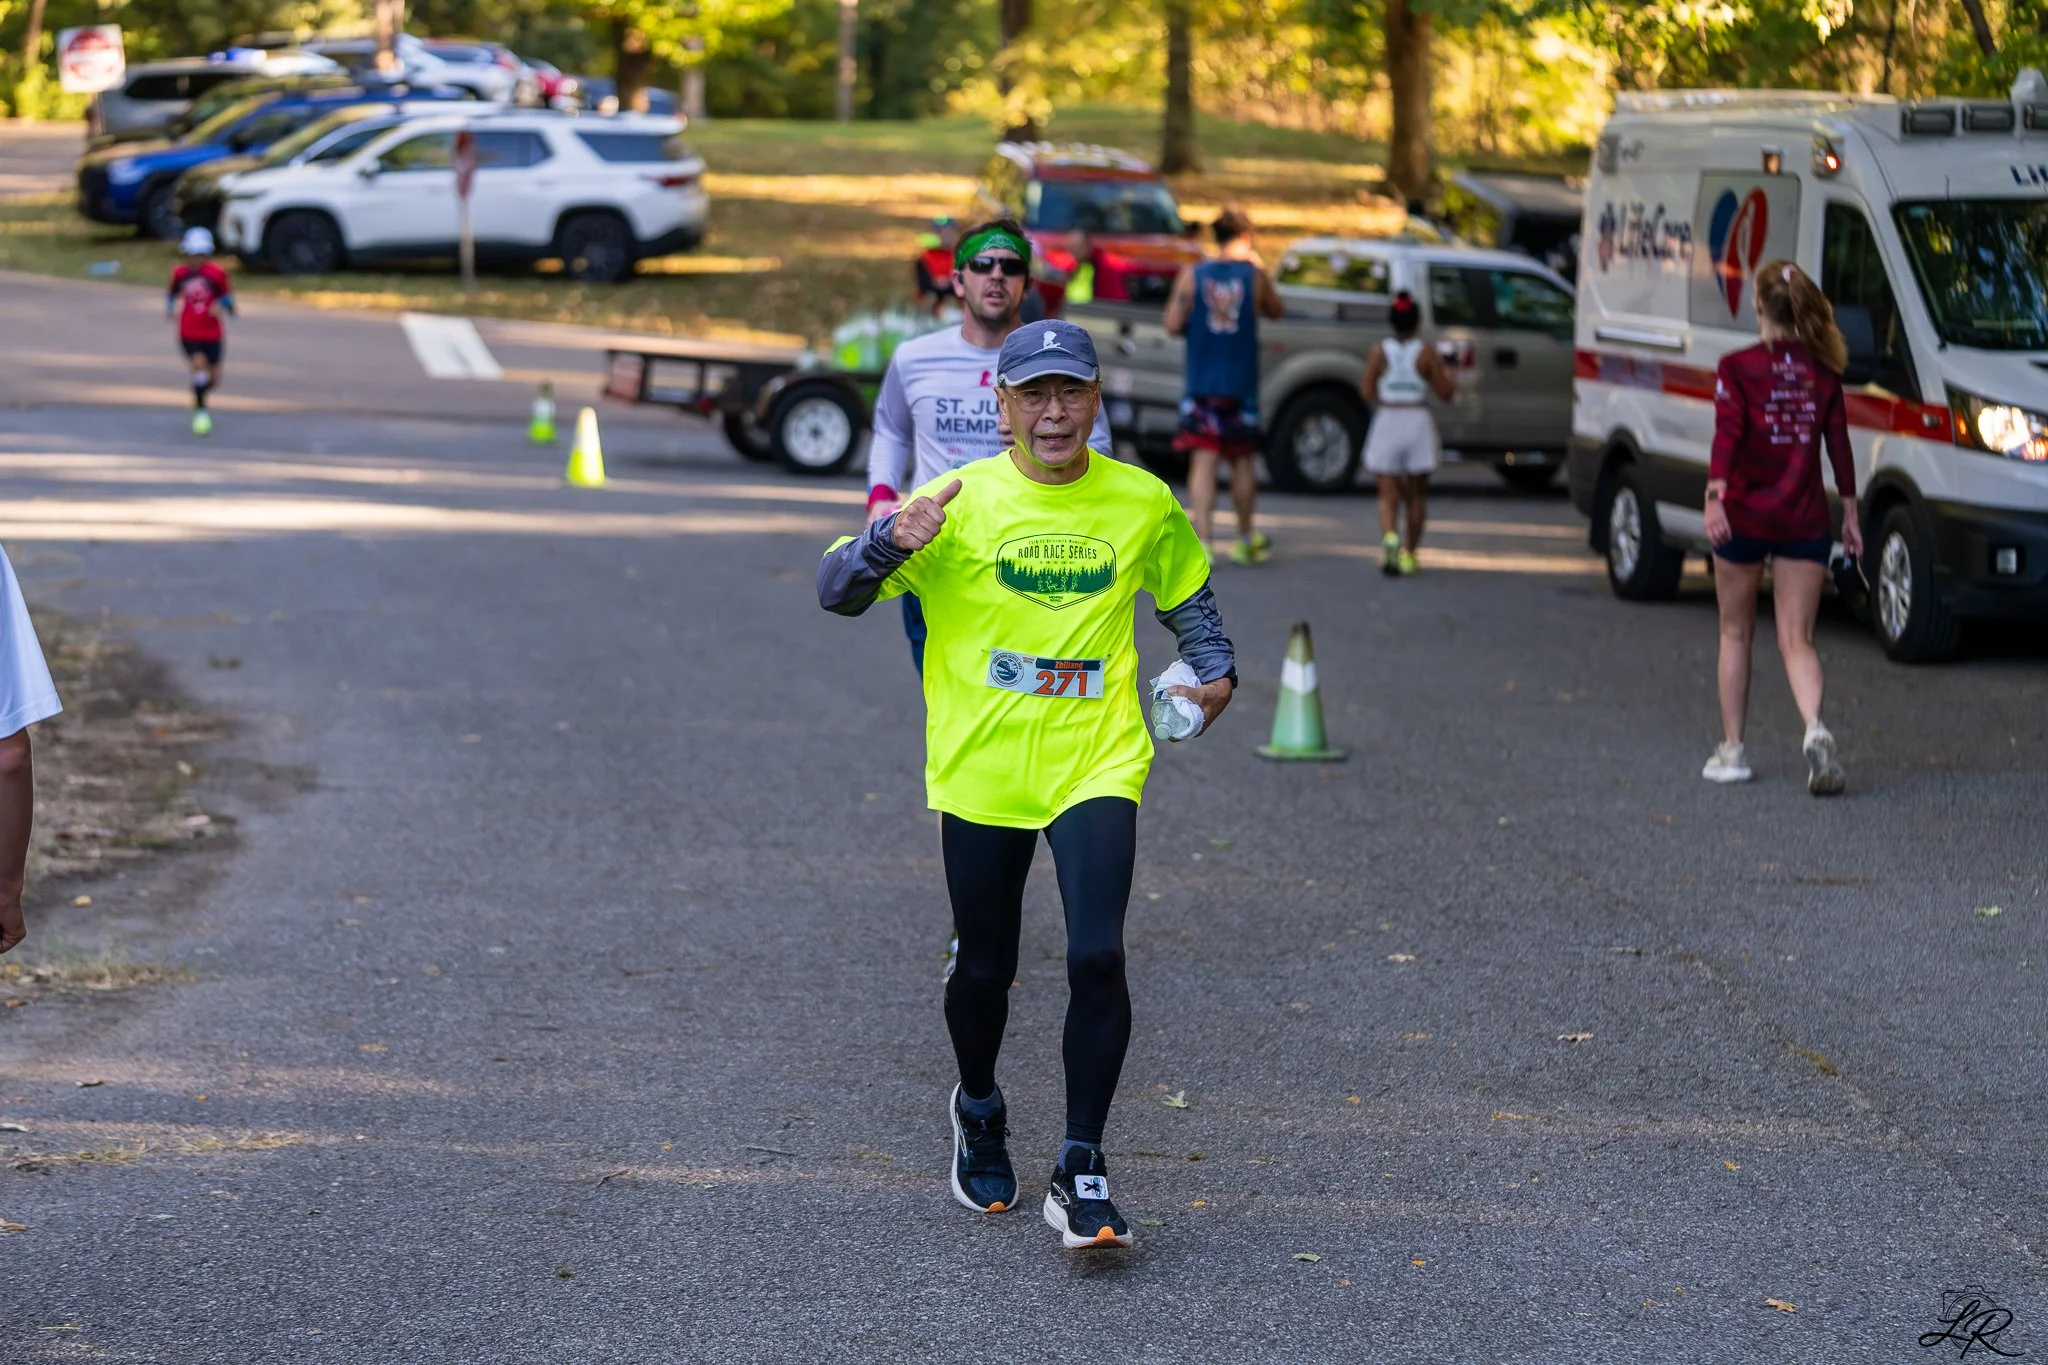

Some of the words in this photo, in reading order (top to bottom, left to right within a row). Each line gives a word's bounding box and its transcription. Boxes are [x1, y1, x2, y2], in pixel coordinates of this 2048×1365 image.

[936, 398, 965, 414] ST.
[971, 399, 1000, 415] JU
[936, 417, 997, 434] MEMP
[1018, 545, 1040, 559] ROAD
[1044, 544, 1065, 559] RACE
[1068, 544, 1097, 560] SERIES
[1033, 670, 1088, 697] 271
